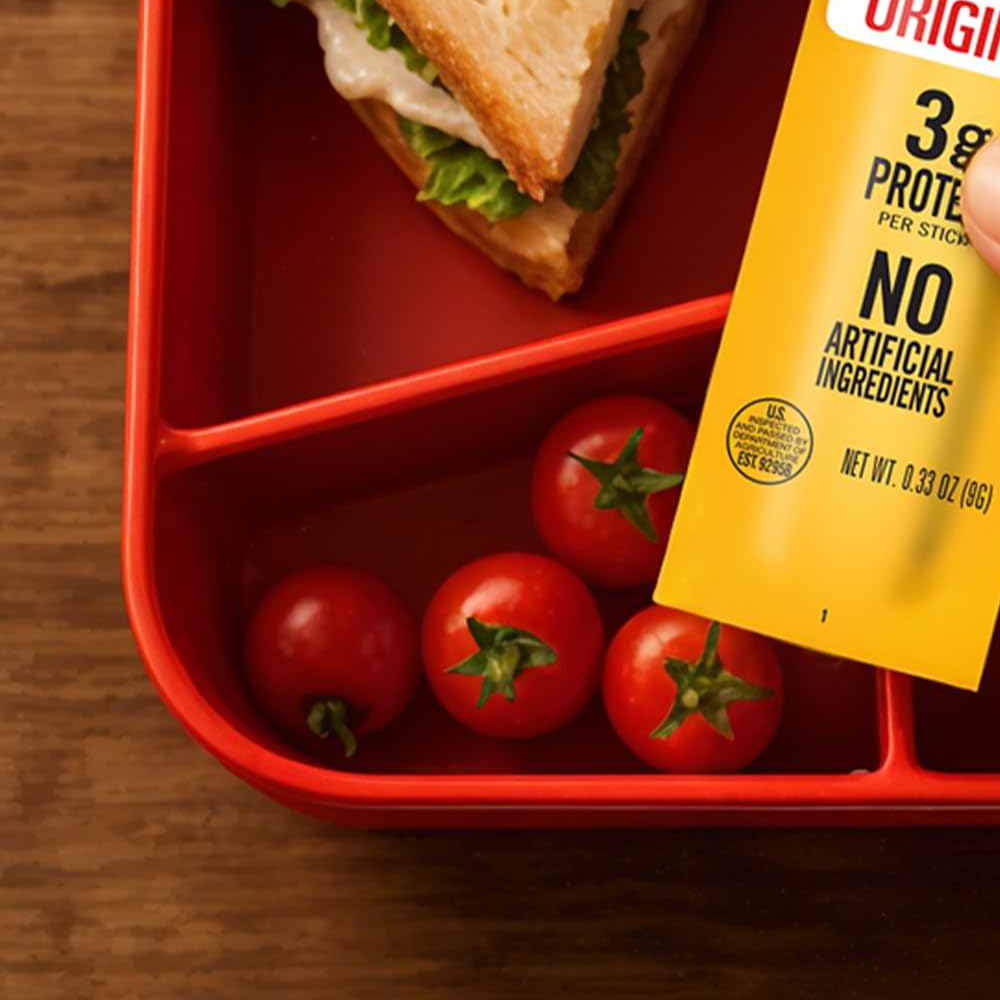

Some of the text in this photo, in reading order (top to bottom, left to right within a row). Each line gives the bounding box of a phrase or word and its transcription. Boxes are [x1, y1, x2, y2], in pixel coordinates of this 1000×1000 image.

[905, 88, 993, 170] 3g
[864, 156, 963, 223] PROTE
[878, 211, 913, 232] PER
[859, 249, 954, 335] NO
[824, 321, 953, 385] ARTIFICIAL
[815, 357, 950, 418] INGREDIENTS
[840, 447, 993, 515] NET WT. 0.33 OZ (9G)
